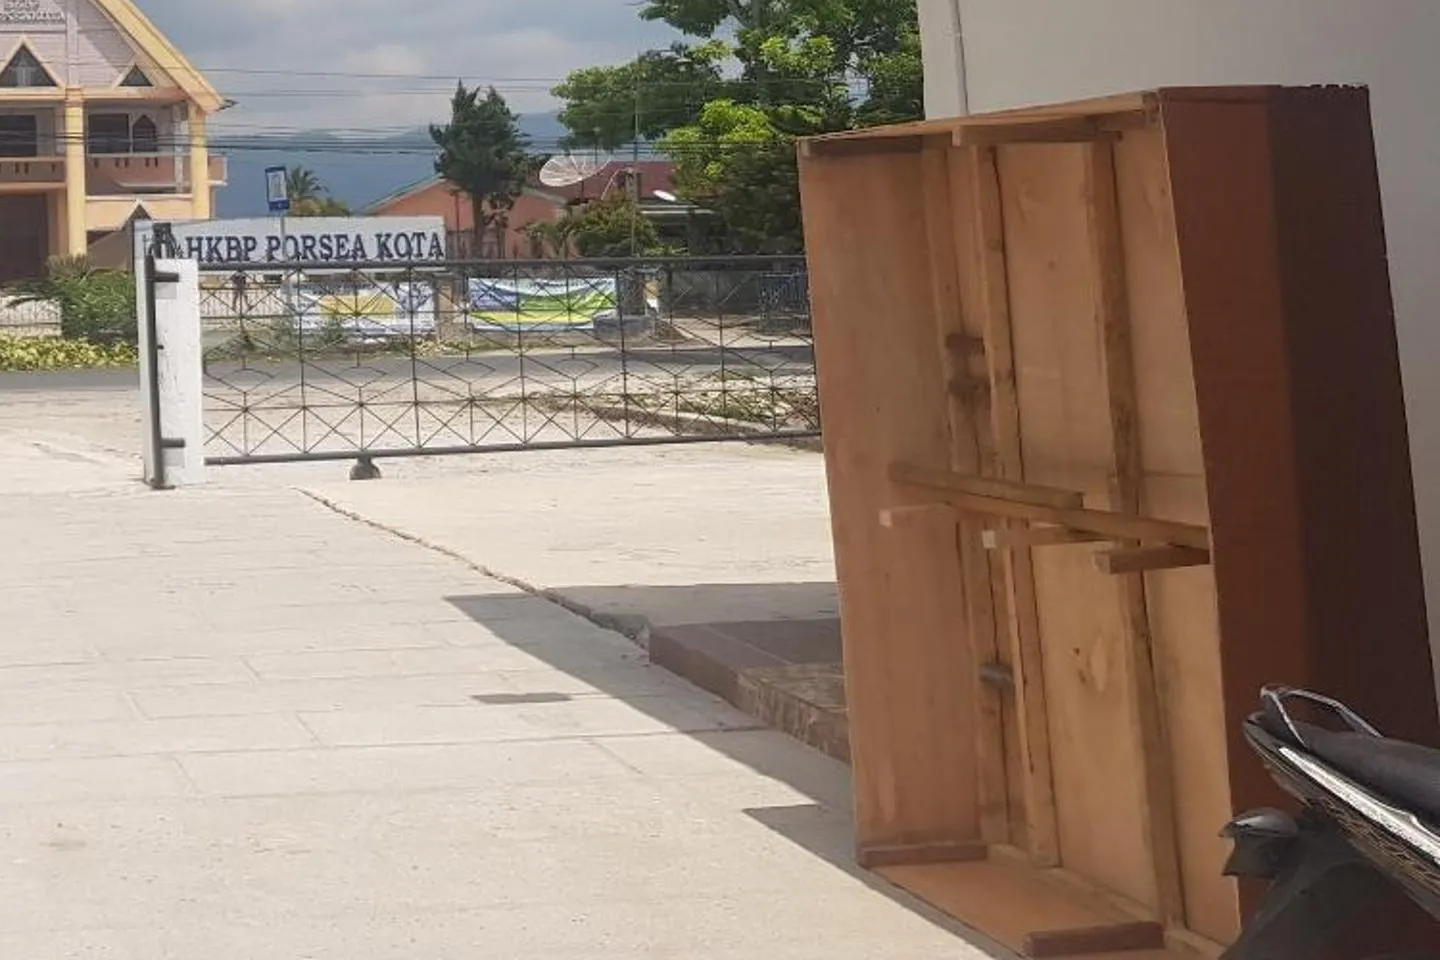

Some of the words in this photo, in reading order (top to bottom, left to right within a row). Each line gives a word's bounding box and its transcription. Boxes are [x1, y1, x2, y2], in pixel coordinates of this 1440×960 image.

[185, 235, 258, 262] HKBP
[266, 234, 368, 261] PORSEA
[374, 232, 445, 259] KOTA
